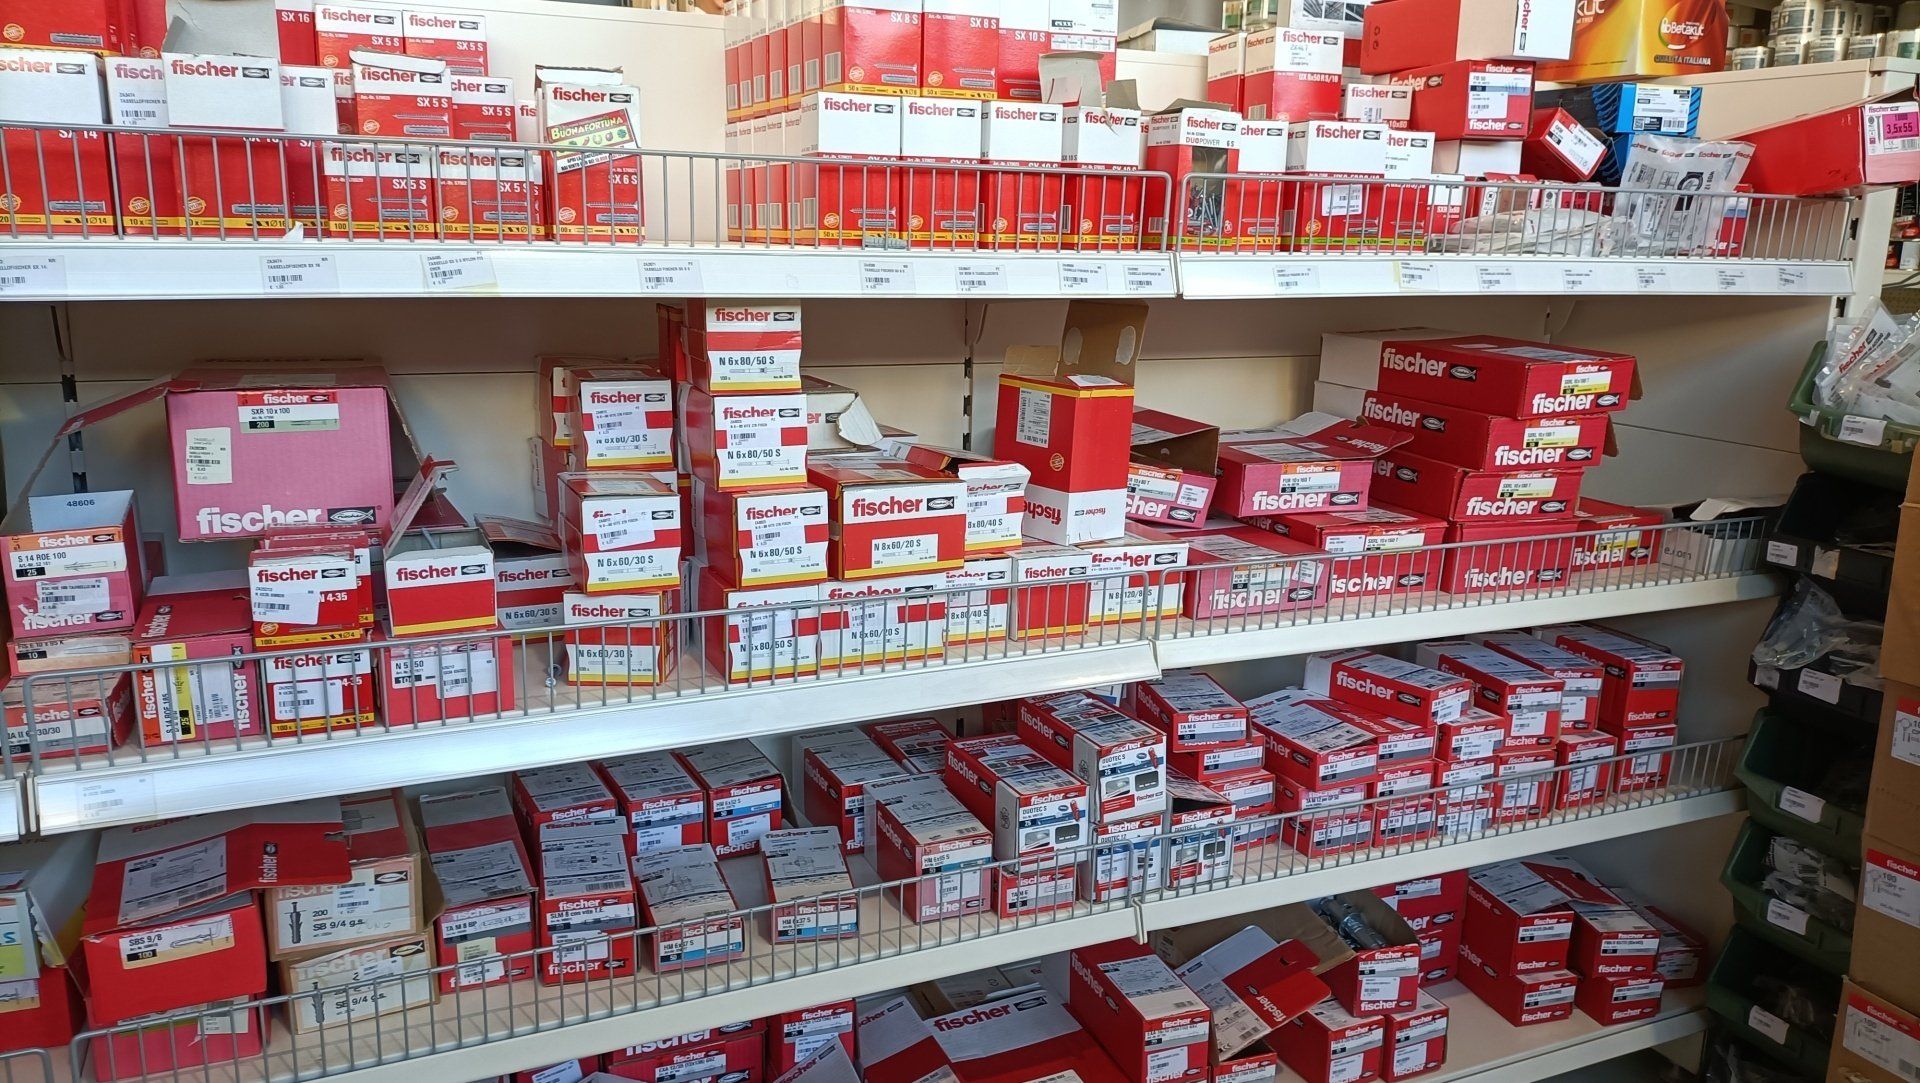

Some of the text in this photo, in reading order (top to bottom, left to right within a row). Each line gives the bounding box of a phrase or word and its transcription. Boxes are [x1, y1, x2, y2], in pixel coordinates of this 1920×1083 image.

[281, 11, 310, 24] SX 16
[322, 8, 371, 24] fischer
[891, 12, 919, 25] SX 8 S
[409, 15, 457, 30] fischer
[970, 17, 997, 29] SX 8 S
[371, 36, 400, 48] SX 5 S
[1015, 30, 1046, 42] SX 10 S
[1282, 30, 1322, 45] fischer
[456, 41, 484, 52] SX 5 S
[1683, 55, 1711, 66] ITALIANA
[171, 60, 239, 78] fischer
[1485, 63, 1515, 74] fischer
[361, 67, 417, 84] fischer
[552, 86, 608, 103] fischer
[1351, 86, 1391, 98] fischer
[416, 97, 448, 109] SX 5 S
[824, 98, 872, 113] fischer
[481, 105, 511, 117] SX 5 S
[908, 102, 955, 117] fischer
[995, 107, 1038, 121] fischer
[1186, 116, 1221, 130] fischer
[1469, 119, 1508, 131] fischer
[1886, 122, 1914, 135] 3,5x55
[1315, 124, 1362, 140] fischer
[331, 148, 392, 164] fischer
[439, 151, 496, 167] fischer
[392, 178, 427, 190] SX 5 S
[623, 175, 638, 185] 6 S
[499, 181, 521, 194] SX 5
[715, 307, 771, 322] fischer
[719, 355, 775, 366] N 6x80/50 S
[1383, 348, 1447, 378] fischer
[1576, 364, 1601, 374] fischer
[263, 393, 311, 405] fischer
[590, 391, 642, 404] fischer
[1532, 392, 1594, 415] fischer
[251, 408, 265, 416] SXR
[279, 407, 290, 415] 100
[723, 406, 777, 420] fischer
[1364, 397, 1420, 428] fischer
[256, 420, 270, 429] 200
[1540, 418, 1566, 427] fischer
[641, 434, 648, 443] S
[727, 448, 781, 460] N 6x80/50 S
[1494, 445, 1565, 466] fischer
[1296, 465, 1325, 474] fischer
[66, 498, 96, 508] 48606
[851, 496, 923, 518] fischer
[1252, 491, 1328, 511] fischer
[1466, 497, 1538, 516] fischer
[197, 504, 321, 534] fischer
[745, 506, 798, 521] fischer
[996, 518, 1003, 527] S
[38, 534, 91, 548] fischer
[874, 539, 921, 551] N 8x60/20 S
[25, 555, 34, 563] 14
[35, 553, 51, 562] ROE
[52, 552, 67, 560] 100
[749, 546, 802, 559] N 6x80/50 S
[597, 555, 654, 568] N 6x60/30 S
[27, 568, 37, 577] 25
[257, 568, 319, 583] fischer
[396, 565, 459, 582] fischer
[498, 569, 550, 583] fischer
[1025, 566, 1068, 580] fischer
[326, 592, 348, 602] 4-35
[505, 607, 558, 620] N 6x60/30 S
[571, 603, 626, 618] fischer
[851, 631, 858, 640] N
[893, 627, 900, 636] S
[260, 638, 273, 646] 100
[740, 639, 793, 652] N S
[28, 651, 38, 659] 10
[578, 649, 585, 659] N
[395, 662, 402, 670] N
[414, 660, 424, 668] 50
[1336, 671, 1395, 700] fischer
[1516, 686, 1544, 695] fischer
[142, 675, 157, 719] fischer
[181, 717, 189, 727] 25
[1188, 713, 1221, 723] fischer
[1628, 711, 1657, 722] fischer
[1021, 706, 1055, 741] fischer
[1180, 723, 1187, 731] TA
[1387, 732, 1415, 743] fischer
[1505, 736, 1538, 747] fischer
[1101, 753, 1126, 765] DUOTEC S
[1328, 751, 1356, 763] fischer
[1104, 768, 1112, 776] 25
[1384, 769, 1411, 781] fischer
[730, 784, 762, 797] fischer
[642, 798, 677, 811] fischer
[1030, 792, 1064, 806] fischer
[551, 806, 588, 821] fischer
[1022, 807, 1042, 816] DUOTEC
[1181, 810, 1213, 825] fischer
[1024, 820, 1032, 828] 25
[1108, 820, 1140, 834] fischer
[939, 838, 972, 852] fischer
[259, 852, 278, 883] fischer
[558, 899, 601, 911] fischer
[313, 909, 329, 918] 200
[312, 920, 347, 933] SB 9/4
[782, 918, 792, 927] HM
[1534, 917, 1559, 926] fischer
[129, 932, 163, 947] SBS 9/8
[663, 940, 695, 952] HM S
[138, 951, 154, 960] 100
[1375, 952, 1403, 961] fischer
[548, 960, 601, 976] fischer
[1517, 959, 1548, 971] fischer
[1598, 964, 1632, 974] fischer
[1361, 999, 1397, 1012] fischer
[802, 1008, 833, 1021] fischer
[934, 1002, 1012, 1033] fischer
[1521, 1011, 1553, 1023] fischer
[1612, 1009, 1643, 1021] fischer
[1162, 1017, 1192, 1029] fischer
[1410, 1015, 1434, 1027] fischer
[1345, 1027, 1370, 1038] fischer
[673, 1051, 707, 1064] fischer
[1232, 1061, 1260, 1073] fischer
